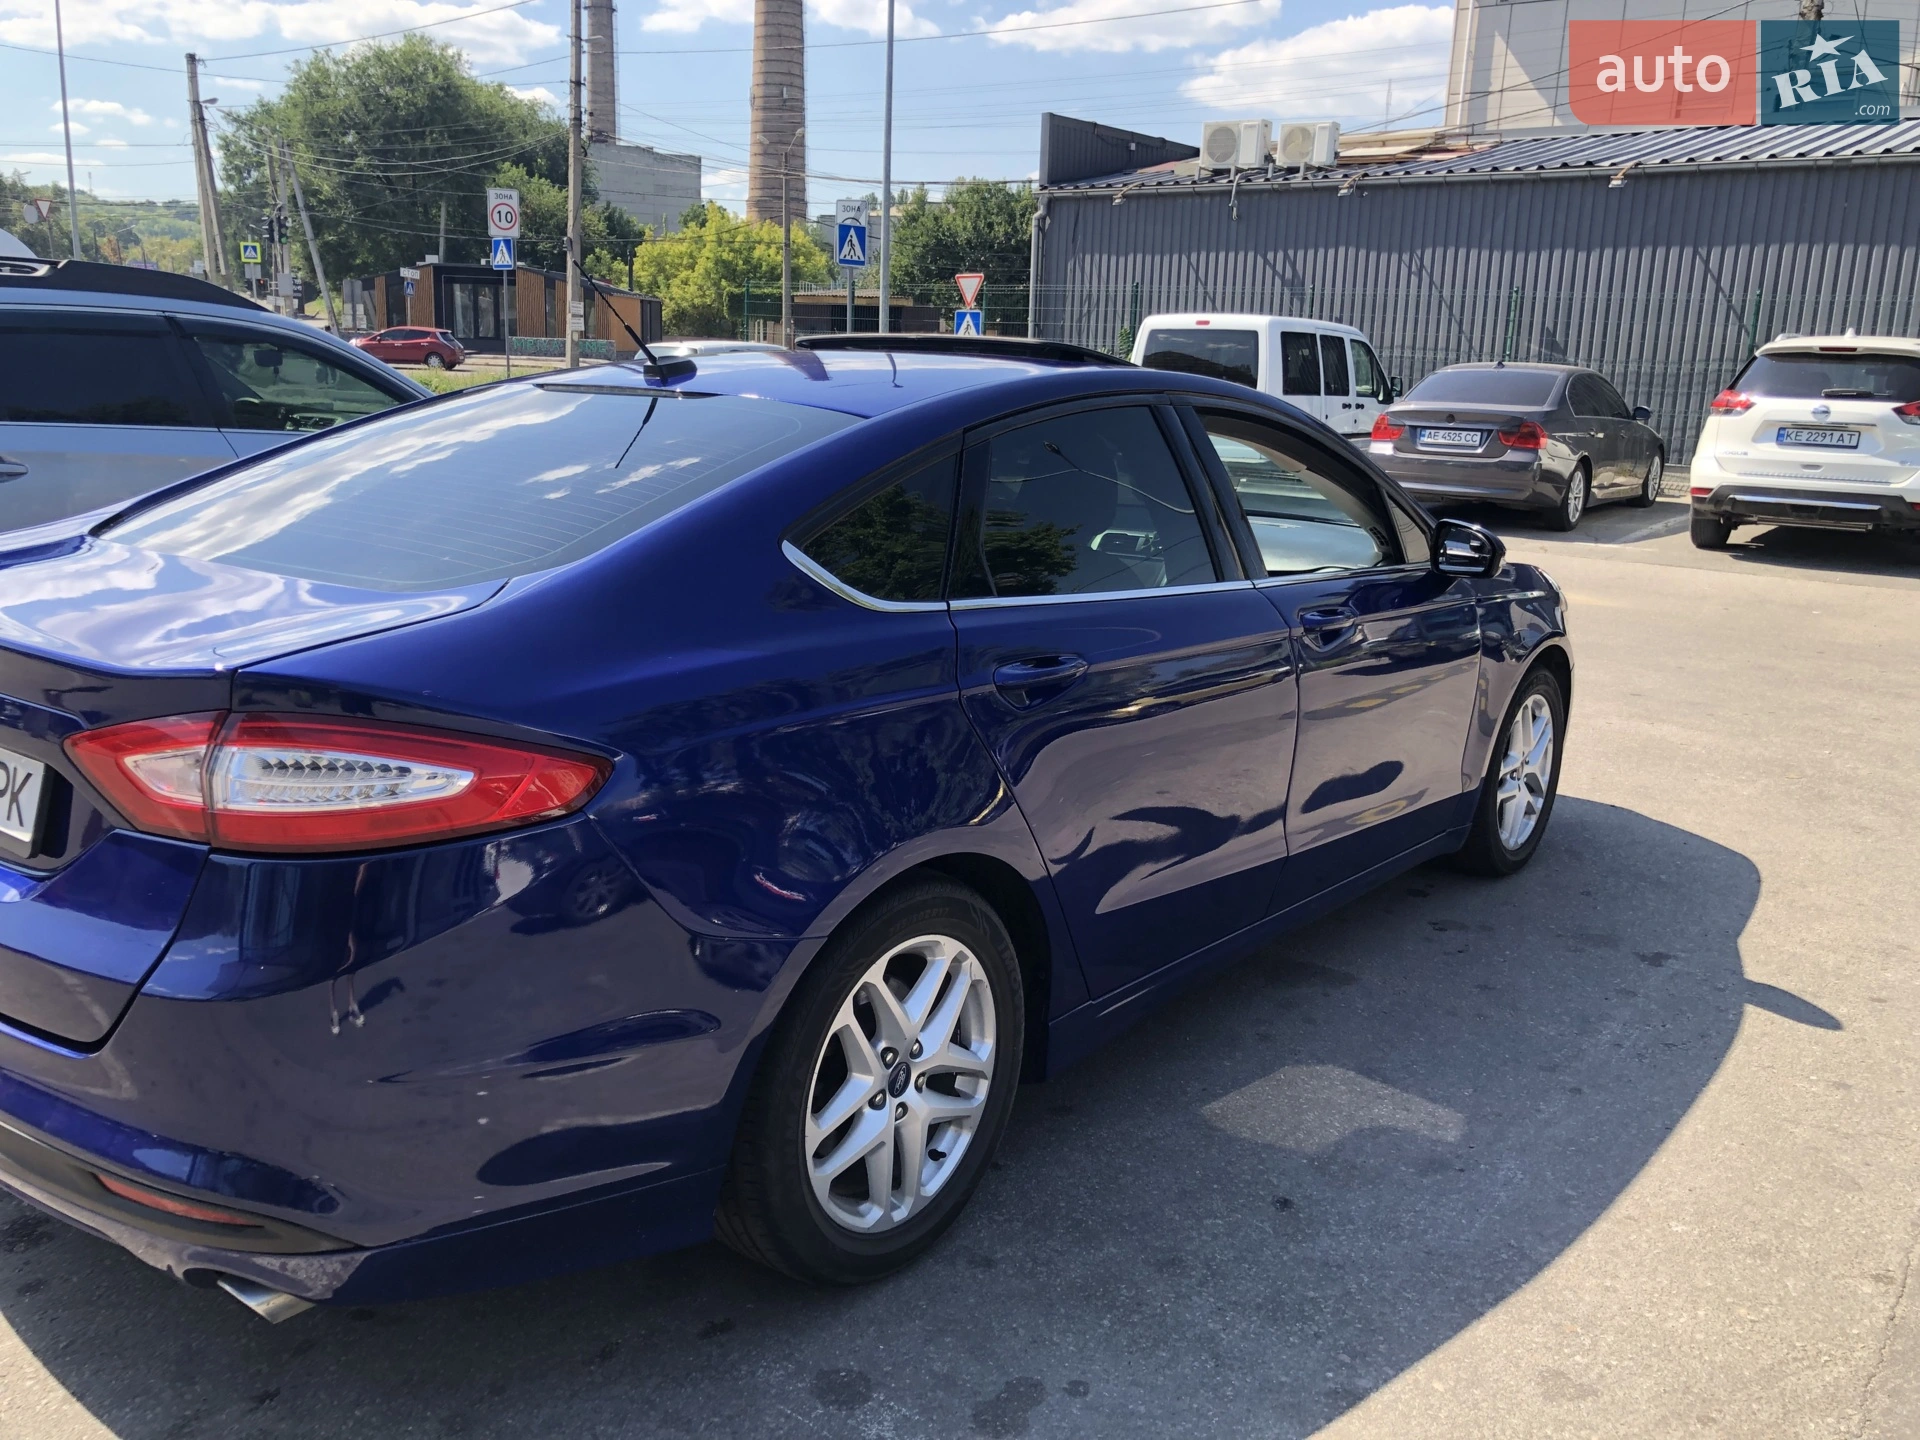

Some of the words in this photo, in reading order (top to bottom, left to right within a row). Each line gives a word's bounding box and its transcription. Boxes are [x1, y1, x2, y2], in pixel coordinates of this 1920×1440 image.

[497, 210, 513, 223] 10
[1427, 431, 1440, 440] AE
[1442, 432, 1462, 441] 4525
[1464, 434, 1478, 442] CC
[1786, 430, 1803, 441] KE
[1806, 431, 1834, 443] 2291
[1836, 433, 1855, 444] AT
